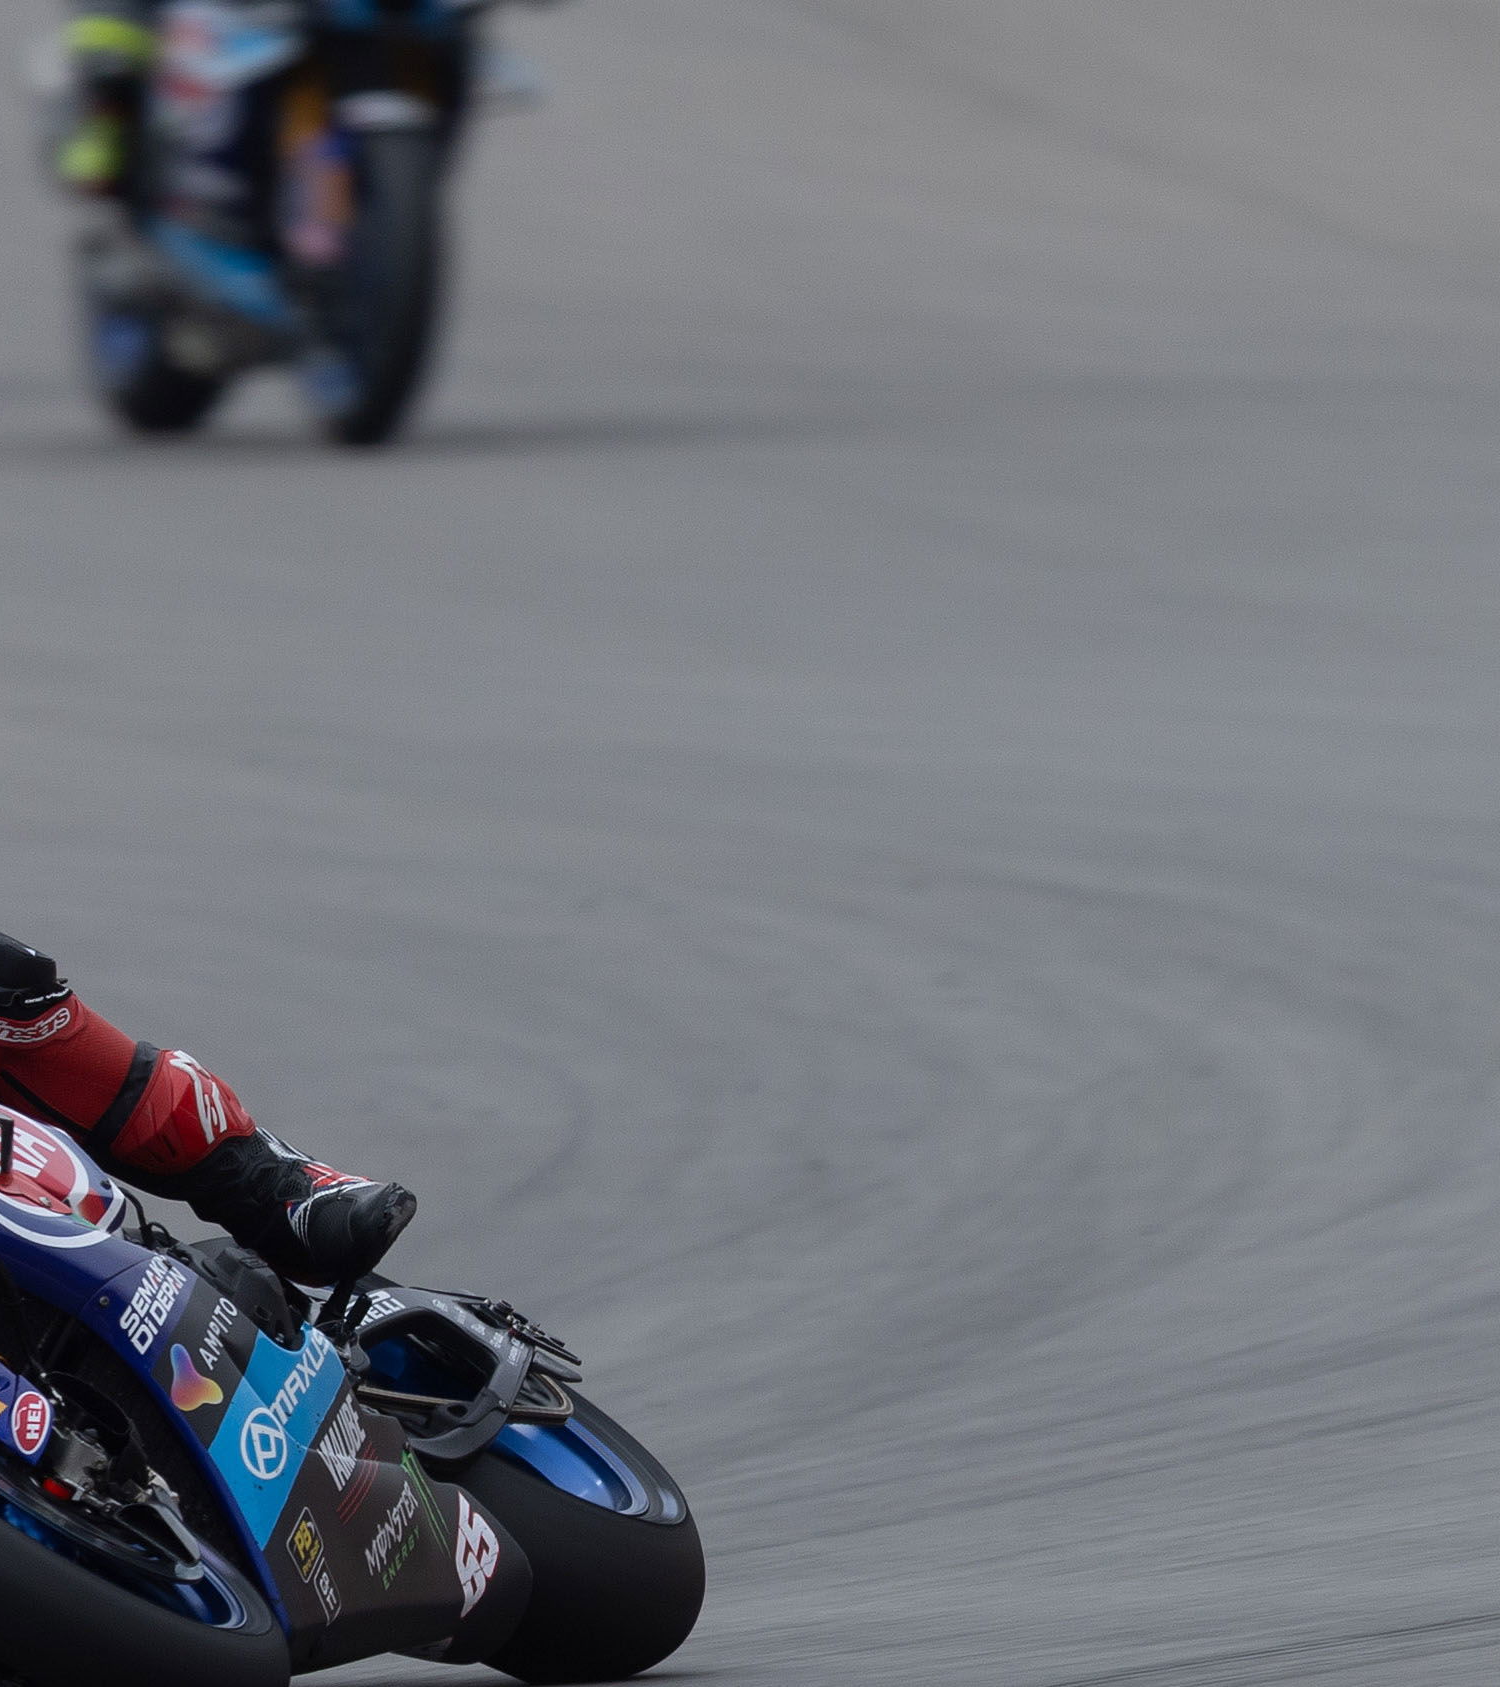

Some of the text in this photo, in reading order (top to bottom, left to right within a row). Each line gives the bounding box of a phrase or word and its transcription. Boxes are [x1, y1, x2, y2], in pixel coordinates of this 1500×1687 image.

[155, 1266, 188, 1326] DEPAN
[198, 1297, 239, 1371] AMPITO
[268, 1327, 334, 1425] MAXUS
[25, 1399, 44, 1441] HEL
[381, 1525, 421, 1591] ENERGY
[455, 1490, 500, 1619] 65
